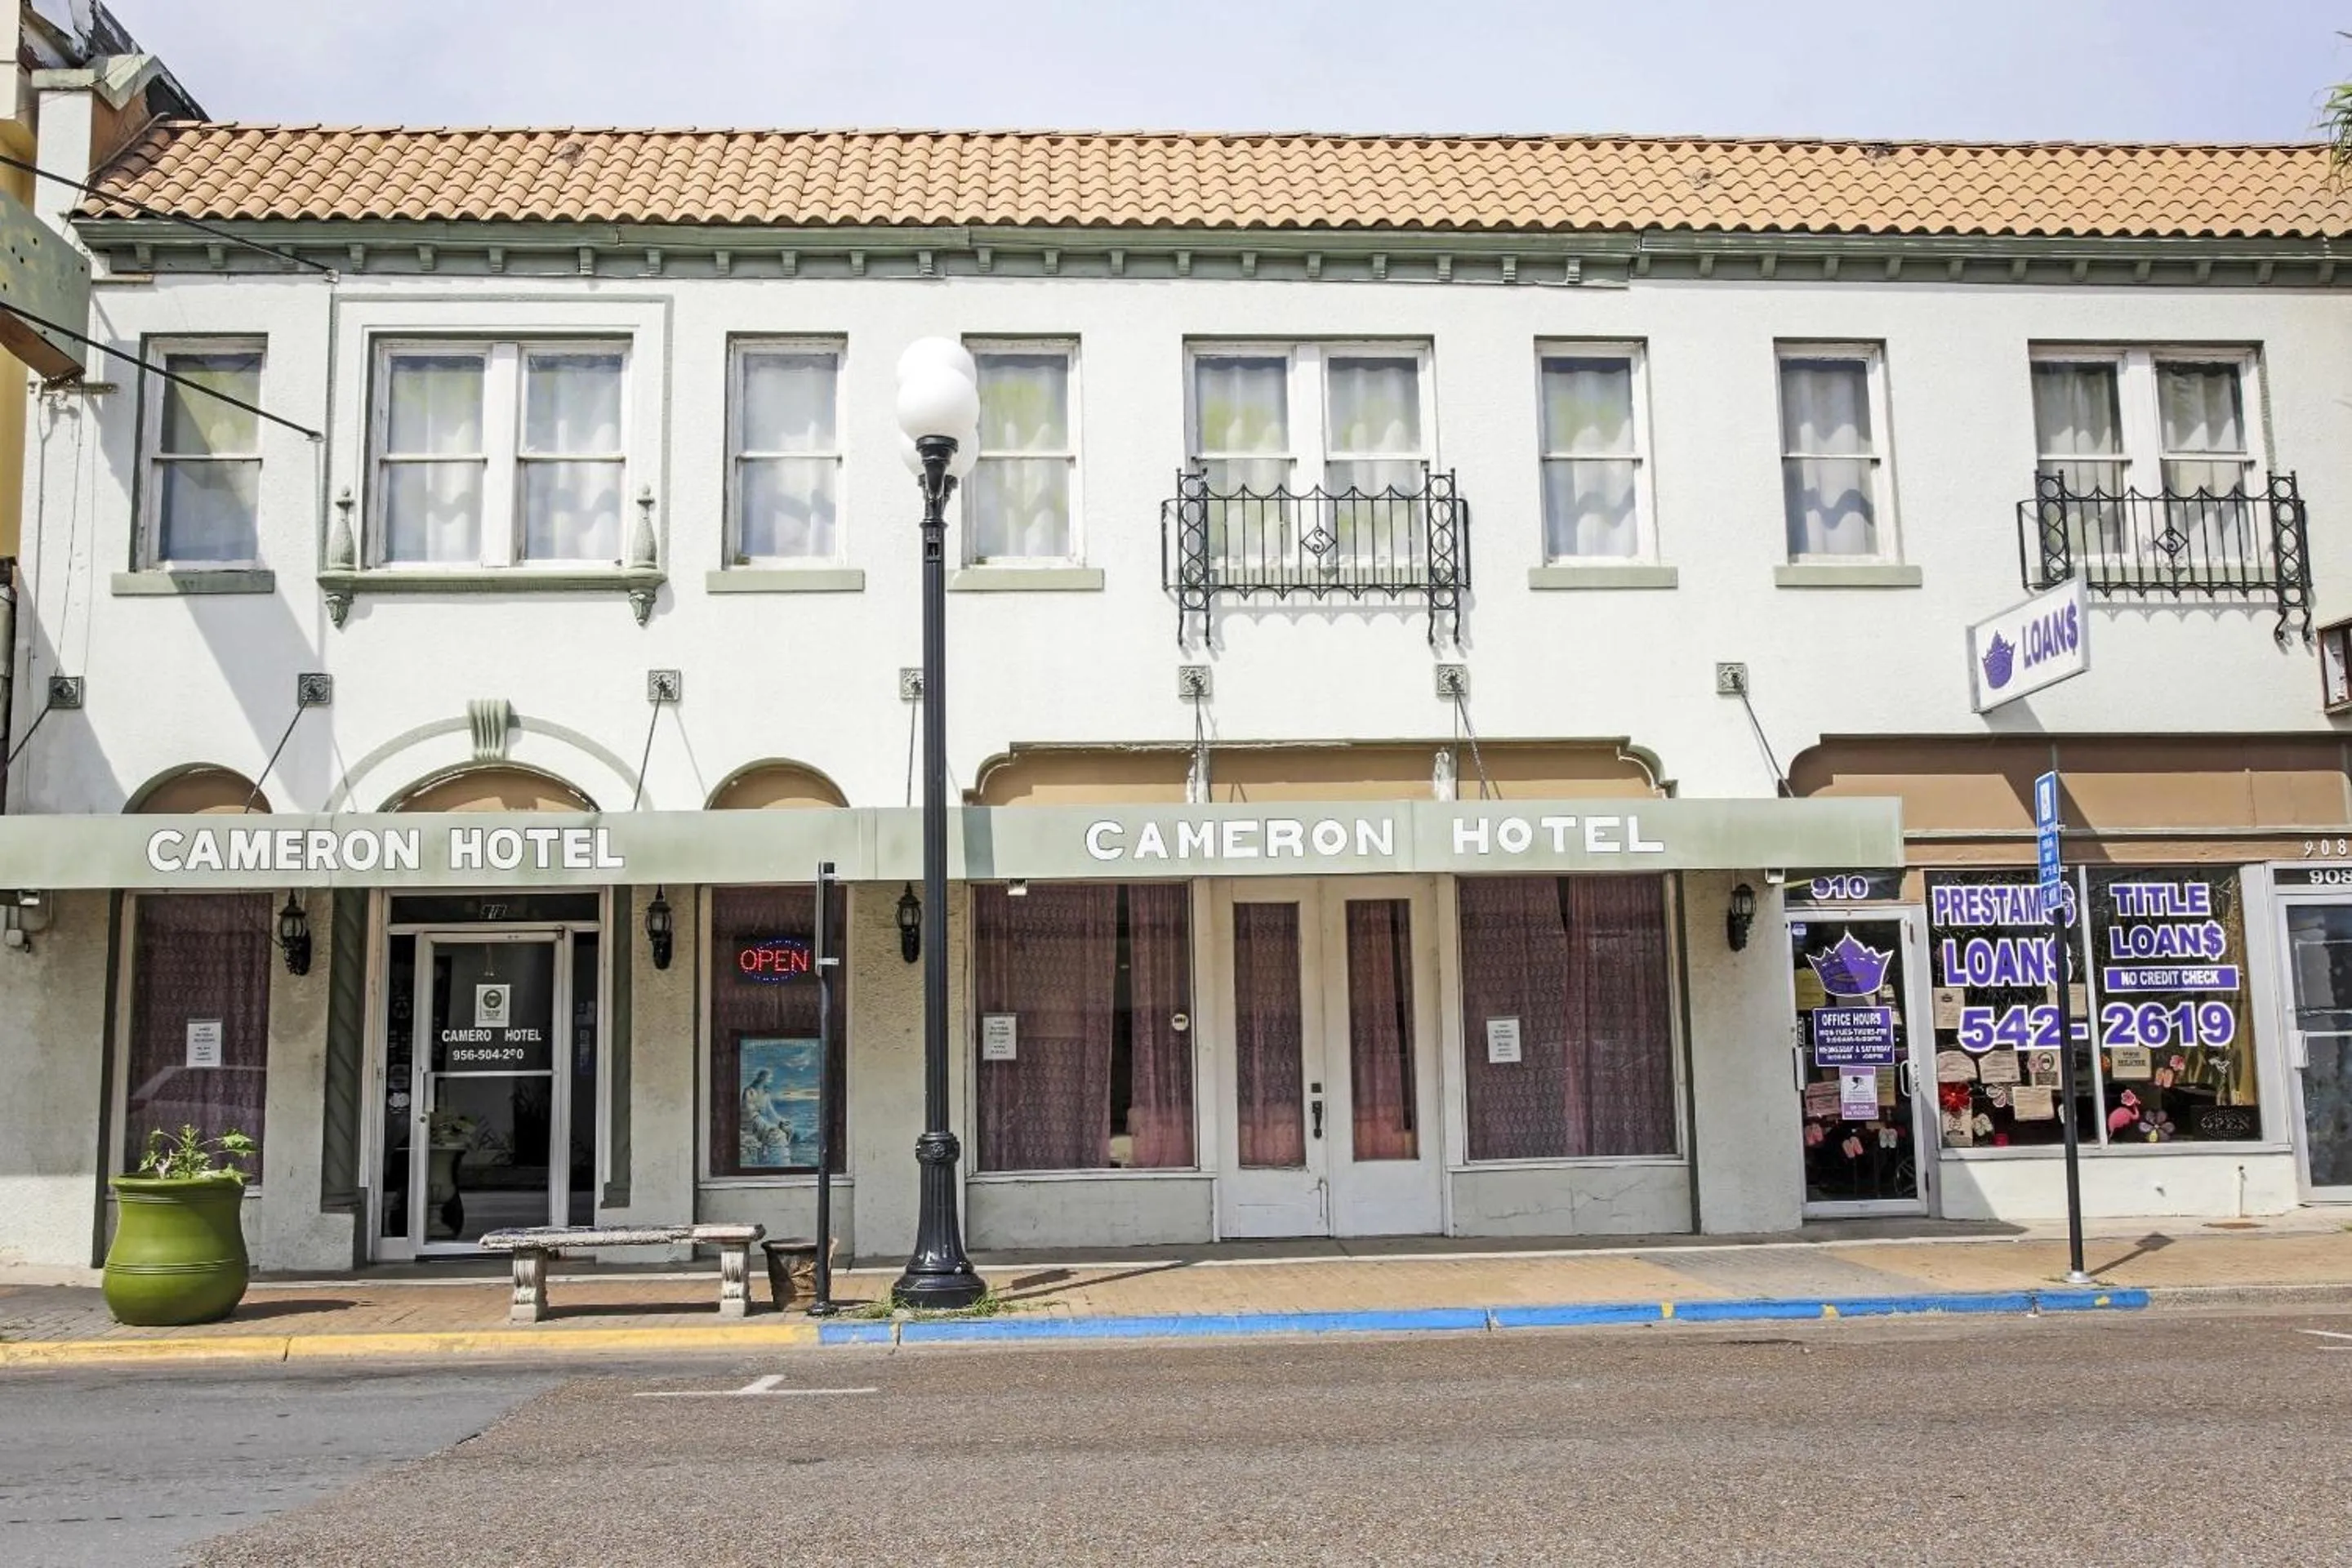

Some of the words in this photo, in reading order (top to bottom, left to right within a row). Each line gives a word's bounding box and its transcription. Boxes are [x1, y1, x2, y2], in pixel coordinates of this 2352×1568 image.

[145, 828, 421, 871] CAMERON
[449, 827, 626, 871] HOTEL
[1085, 818, 1394, 860] CAMERON
[1453, 815, 1665, 855] HOTEL
[2305, 838, 2346, 856] 908
[1811, 874, 1869, 899] 910
[2309, 869, 2352, 884] 908
[2109, 882, 2212, 916] TITLE
[2109, 920, 2226, 961] LOAN$
[740, 948, 809, 972] OPEN
[2121, 971, 2137, 986] NO
[2140, 970, 2180, 986] CREDIT
[2181, 969, 2220, 985] CHECK
[1821, 1013, 1851, 1026] OFFICE
[1853, 1013, 1882, 1025] HOURS
[2100, 1000, 2236, 1048] 2619
[504, 1029, 542, 1041] HOTEL
